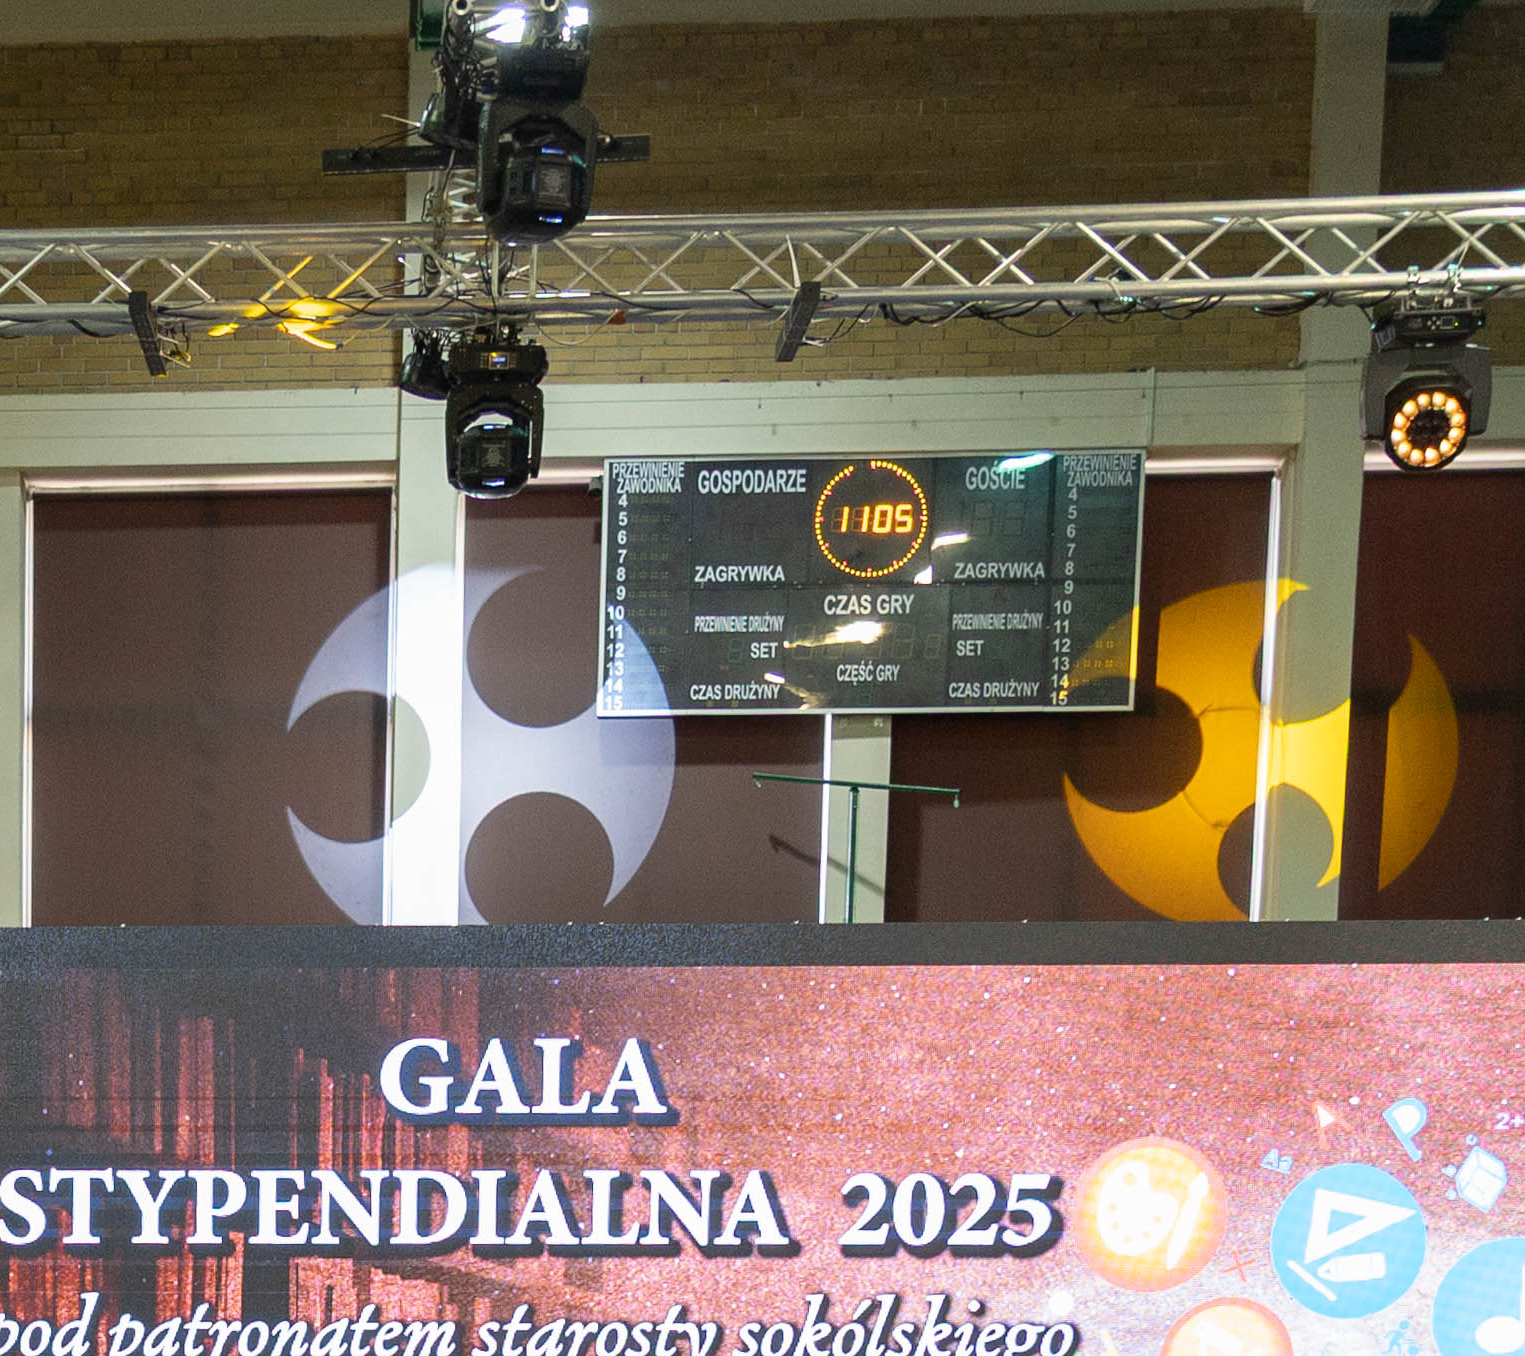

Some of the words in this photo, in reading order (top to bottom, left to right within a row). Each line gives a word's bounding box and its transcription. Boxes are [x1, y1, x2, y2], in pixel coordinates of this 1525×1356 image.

[613, 462, 685, 480] PRZEWINIENIE
[1063, 455, 1137, 472] PRZEWINIENIE
[698, 469, 807, 494] GOSPODARZE
[966, 461, 1025, 490] GOŚCIE
[1067, 471, 1133, 487] ZAWODNIKA
[616, 477, 682, 494] ZAWODNIKA
[618, 494, 628, 508] 4
[1069, 487, 1078, 501] 4
[618, 512, 628, 526] 5
[1068, 505, 1077, 519] 5
[617, 530, 627, 544] 6
[1067, 524, 1076, 538] 6
[617, 550, 627, 564] 7
[1067, 544, 1076, 558] 7
[616, 567, 626, 582] 8
[694, 565, 785, 583] ZAGRYWKA
[954, 562, 1045, 580] ZAGRYWKA
[1065, 562, 1074, 576] 8
[616, 586, 626, 601] 9
[1064, 581, 1074, 595] 9
[824, 594, 872, 615] CZAS
[876, 594, 914, 615] GRY
[1054, 600, 1072, 615] 10
[607, 605, 625, 621] 10
[1007, 609, 1044, 630] DRUŻYNY
[748, 612, 785, 633] DRUŻYNY
[1053, 620, 1070, 634] 11
[607, 625, 623, 639] 11
[606, 642, 624, 658] 12
[750, 642, 778, 658] SET
[956, 640, 984, 656] SET
[1053, 639, 1071, 653] 12
[606, 662, 624, 676] 13
[1052, 657, 1070, 671] 13
[837, 660, 874, 685] CZĘŚĆ
[875, 664, 900, 682] GRY
[605, 678, 624, 694] 14
[949, 682, 980, 698] CZAS
[983, 679, 1040, 697] DRUŻYNY
[1051, 674, 1069, 688] 14
[690, 685, 722, 700] CZAS
[725, 680, 781, 700] DRUŻYNY
[604, 696, 623, 711] 15
[1050, 691, 1068, 706] 15
[379, 1037, 667, 1117] GALA
[1382, 1096, 1429, 1162] P
[841, 1172, 1055, 1248] 2025
